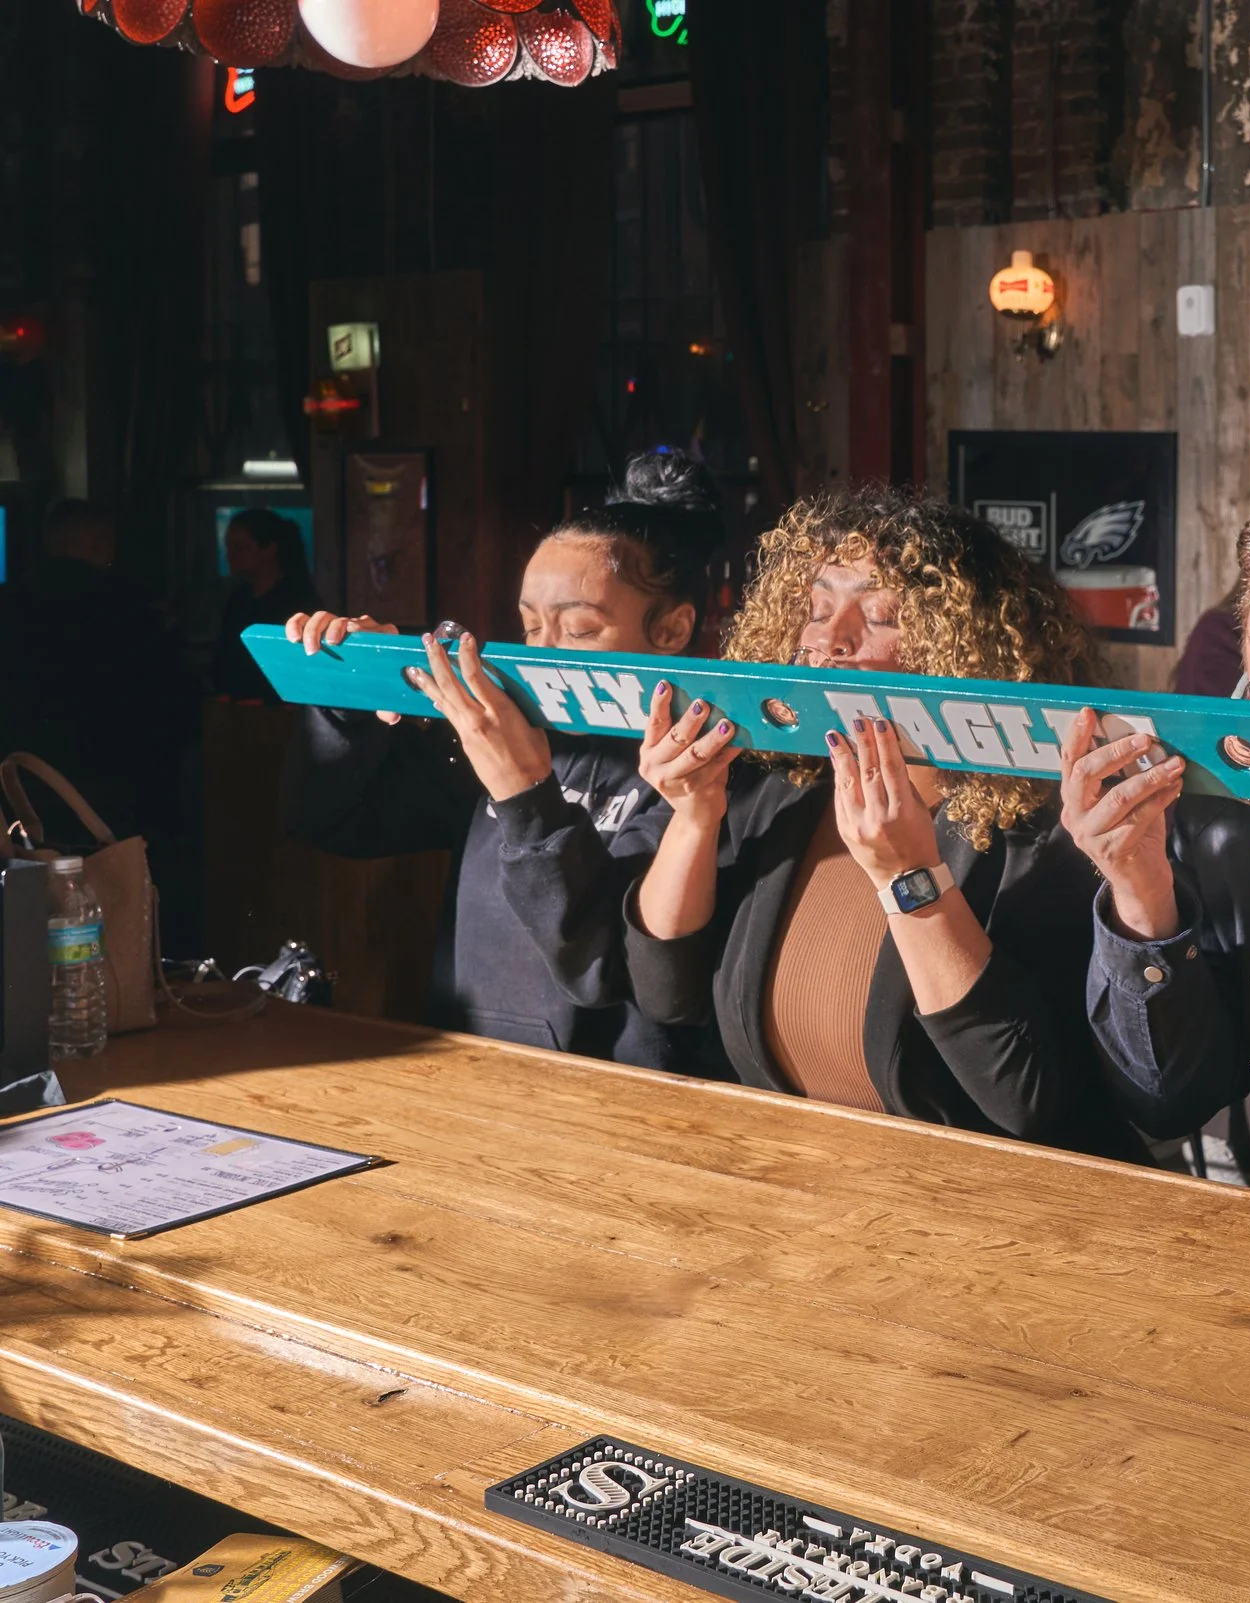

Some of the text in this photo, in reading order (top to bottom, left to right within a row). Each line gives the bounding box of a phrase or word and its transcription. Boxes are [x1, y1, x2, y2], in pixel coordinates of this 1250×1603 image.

[986, 507, 1033, 528] BUD
[515, 664, 650, 732] FLY
[849, 1526, 964, 1583] VODKA
